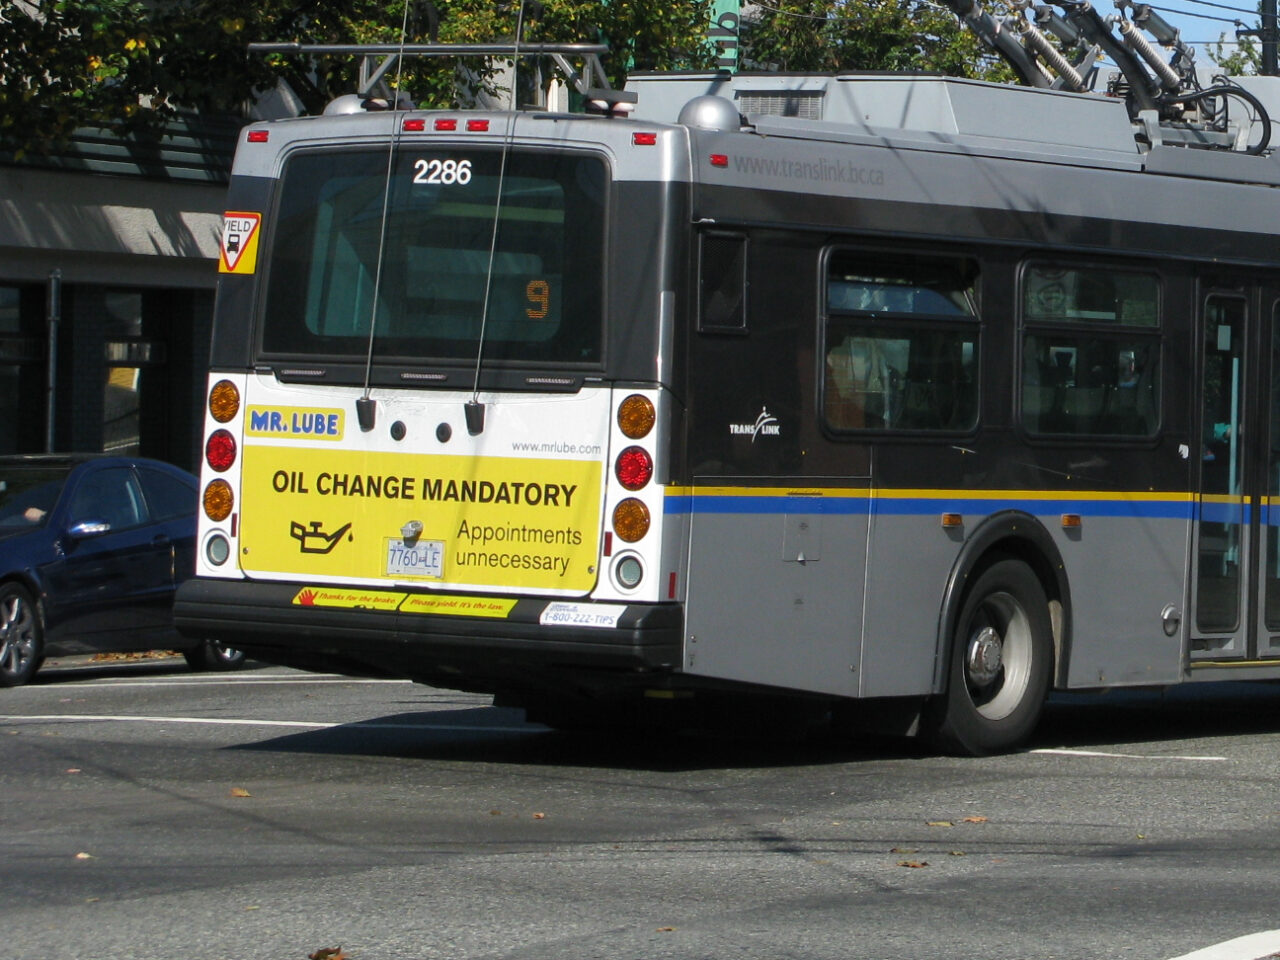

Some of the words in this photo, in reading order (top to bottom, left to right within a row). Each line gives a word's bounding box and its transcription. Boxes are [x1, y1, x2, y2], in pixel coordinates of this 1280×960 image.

[413, 159, 472, 185] 2286
[734, 156, 884, 186] www.translink.bc.ca
[526, 280, 550, 319] 9
[250, 410, 288, 432] MR.
[292, 412, 339, 435] LUBE
[729, 424, 755, 434] TRANS
[761, 425, 780, 435] LINK
[512, 441, 602, 455] www.mrlube.com
[272, 470, 308, 494] OIL
[316, 472, 416, 500] CHANGE
[422, 478, 578, 507] MANDATORY
[457, 519, 582, 546] Appointments
[456, 551, 570, 577] unnecessary
